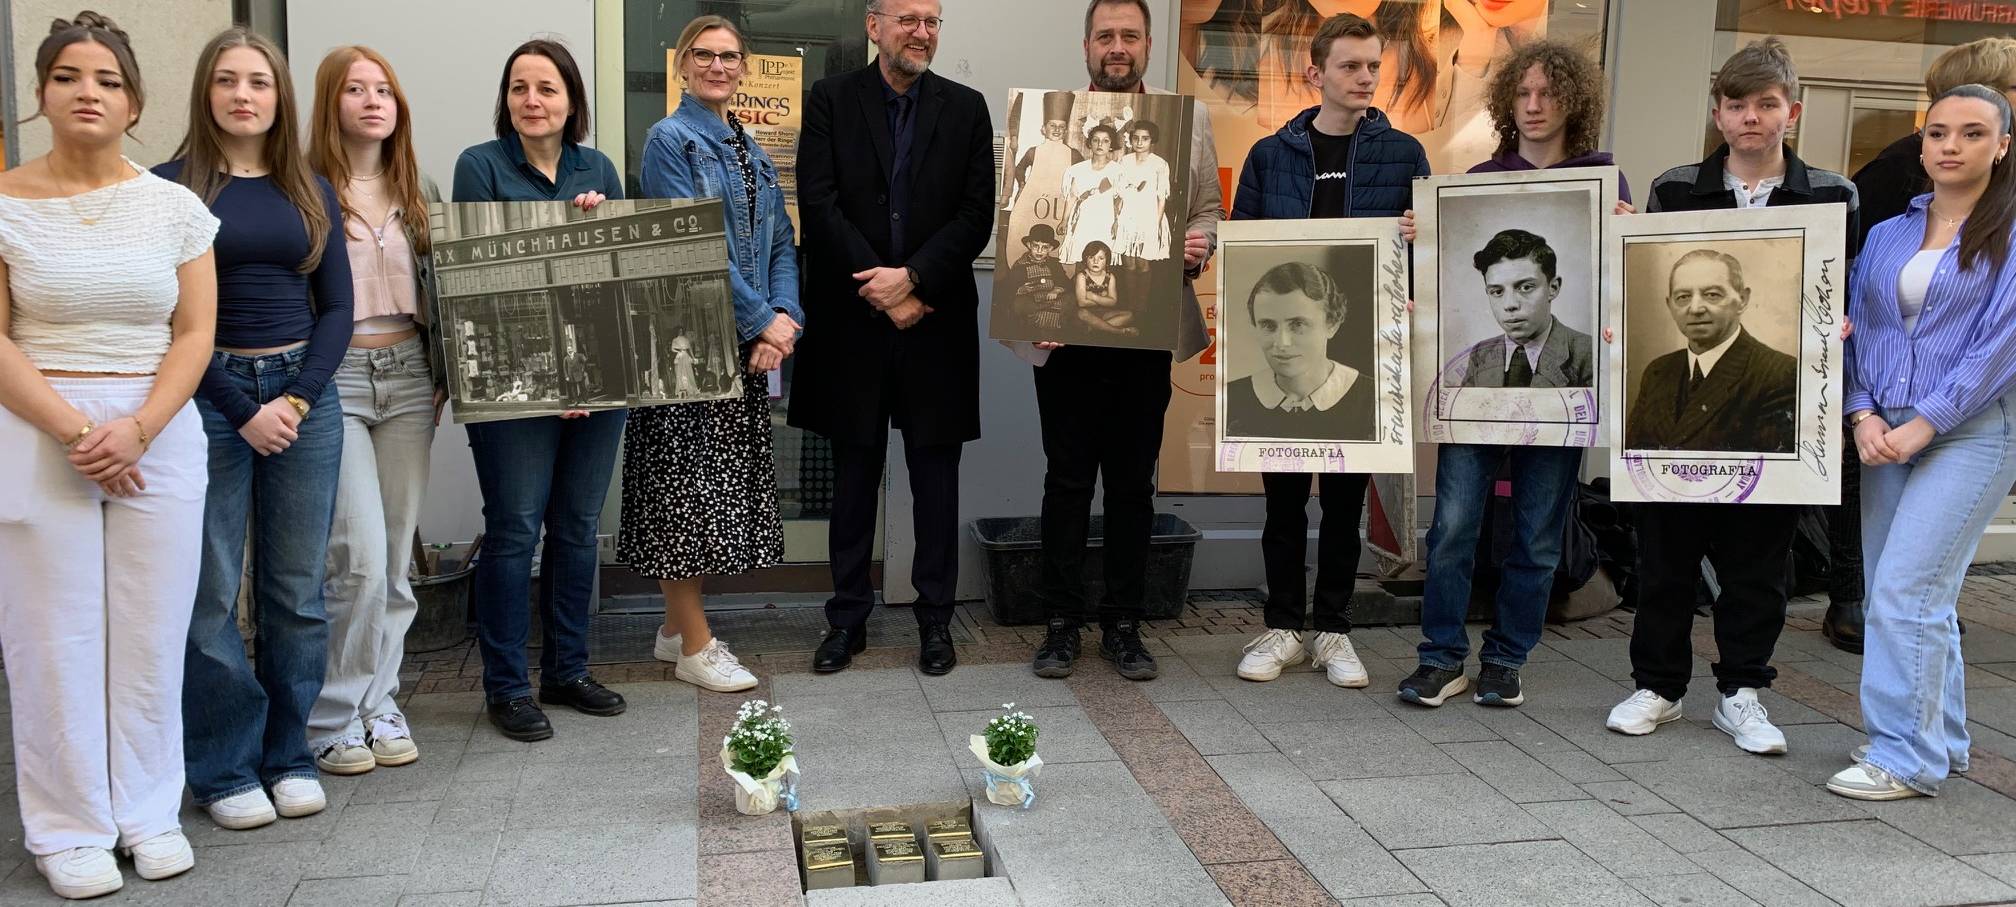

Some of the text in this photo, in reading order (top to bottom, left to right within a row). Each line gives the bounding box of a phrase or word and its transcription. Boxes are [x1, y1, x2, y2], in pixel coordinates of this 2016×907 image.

[736, 92, 790, 117] RINGS
[734, 109, 780, 126] SIC
[471, 223, 641, 261] MÜNCHHAUSEN
[651, 223, 663, 237] &
[1258, 447, 1345, 459] FOTOGRAFIA
[1661, 464, 1758, 476] FOTOGRAFIA
